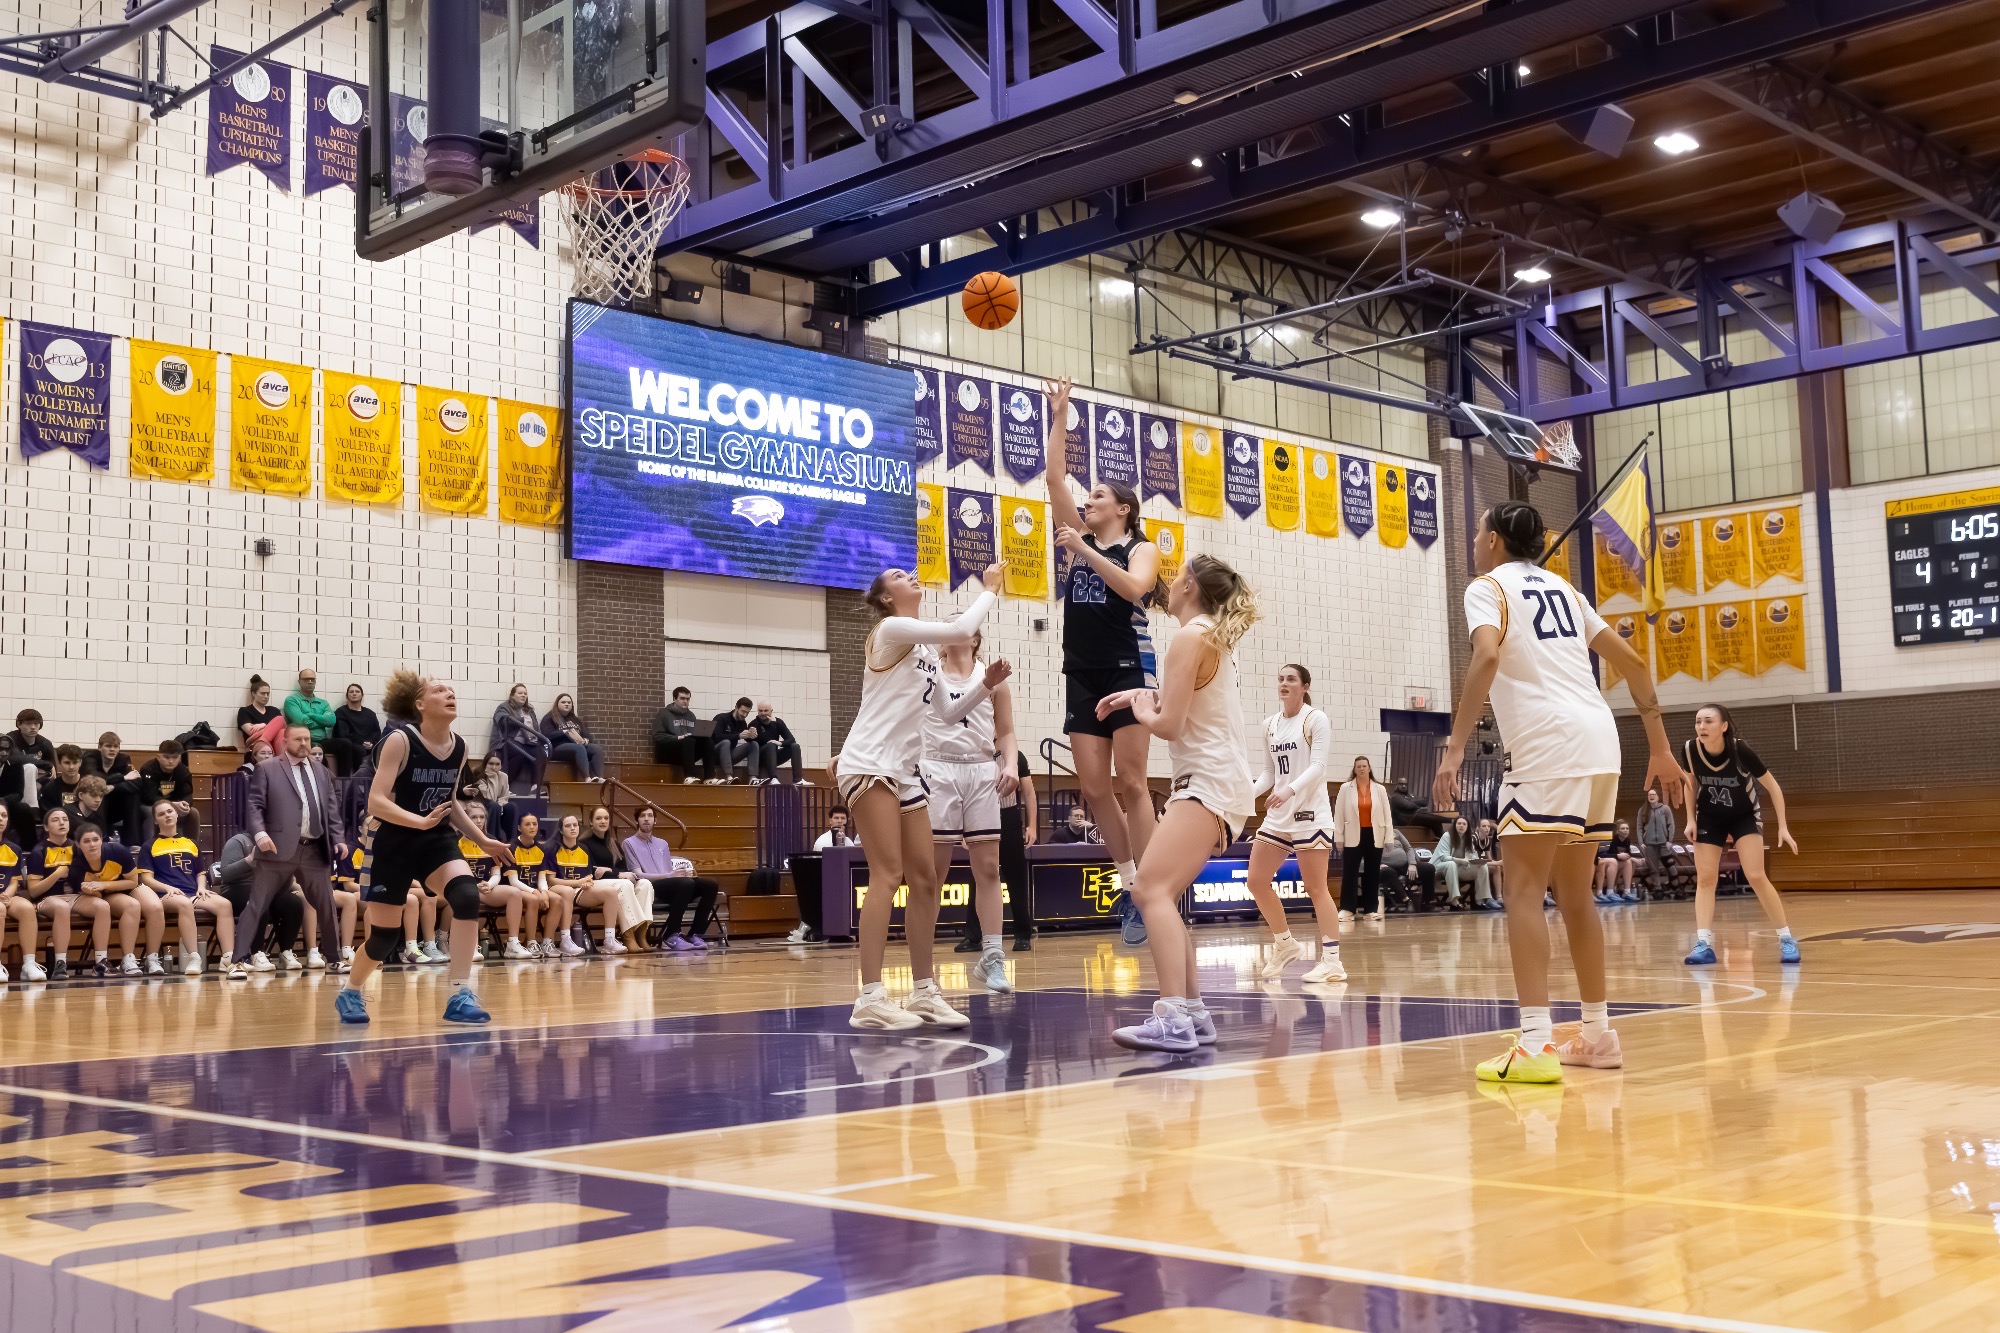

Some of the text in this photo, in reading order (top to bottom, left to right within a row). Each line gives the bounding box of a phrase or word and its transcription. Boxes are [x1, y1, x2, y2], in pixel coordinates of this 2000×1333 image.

[270, 86, 286, 102] 80
[235, 102, 267, 120] MEN'S
[313, 97, 326, 112] 19
[219, 112, 283, 138] BASKETBALL
[393, 117, 405, 132] 19
[222, 127, 279, 150] UPSTATE NY
[330, 126, 358, 142] MEN'S
[218, 140, 282, 164] CHAMPIONS
[315, 136, 357, 154] BASKETB
[318, 150, 357, 168] UPSTATE
[26, 352, 105, 379] 20 13
[36, 379, 95, 400] WOMEN'S
[138, 369, 153, 386] 20
[195, 378, 212, 396] 14
[262, 382, 288, 392] avca
[24, 392, 104, 416] VOLLEYBALL
[238, 384, 307, 413] 20 14
[330, 393, 397, 416] 20 15
[353, 396, 378, 406] avca
[444, 408, 468, 419] avca
[628, 366, 874, 449] WELCOME TO
[1002, 402, 1011, 414] 19
[23, 408, 106, 431] TOURNAMENT
[156, 412, 191, 427] MEN'S
[256, 413, 288, 428] MEN'S
[424, 407, 484, 429] 20 15
[956, 412, 984, 425] WOMEN'S
[38, 427, 92, 446] FINALIST
[136, 424, 210, 444] VOLLEYBALL
[241, 425, 302, 444] VOLLEYBALL
[349, 426, 380, 440] MEN'S
[952, 422, 988, 436] BASKETBALL
[1008, 422, 1034, 435] WOMEN'S
[440, 438, 470, 452] MEN'S
[504, 428, 562, 448] 20 15
[1004, 432, 1038, 447] BASKETBALL
[1102, 439, 1128, 452] WOMEN'S
[138, 438, 210, 459] TOURNAMENT
[244, 440, 289, 456] DIVISION
[336, 438, 392, 455] VOLLEYBALL
[580, 407, 913, 496] SPEIDEL GYMNASIUM
[953, 444, 990, 458] CHAMPIONS
[134, 452, 210, 474] SEMI-FINALIST
[236, 452, 306, 470] ALL-AMERICAN
[337, 451, 380, 466] DIVISION
[428, 450, 479, 467] VOLLEYBALL
[1010, 455, 1036, 466] FINALIST
[1099, 449, 1134, 462] BASKETBALL
[1274, 454, 1288, 464] NCAA
[331, 464, 398, 481] ALL-AMERICAN
[429, 464, 470, 478] DIVISION
[512, 460, 555, 476] WOMEN'S
[1231, 465, 1255, 476] WOMEN'S
[424, 476, 485, 492] ALL-AMERICAN
[506, 472, 561, 491] VOLLEYBALL
[638, 460, 672, 476] HOME
[672, 464, 687, 478] OF
[687, 466, 706, 482] THE
[744, 476, 789, 494] COLLEGE
[832, 488, 867, 506] EAGLES
[1228, 474, 1258, 486] BASKETBALL
[1228, 484, 1259, 496] TOURNAMENT
[1345, 488, 1368, 498] WOMEN'S
[515, 500, 552, 515] FINALIST
[1905, 490, 2000, 513] Home of the Soarin
[958, 529, 988, 541] WOMEN'S
[1951, 512, 1998, 542] 6:05
[953, 539, 992, 552] BASKETBALL
[1010, 537, 1039, 548] WOMEN'S
[953, 548, 992, 562] TOURNAMENT
[1004, 546, 1044, 558] BASKETBALL
[1895, 547, 1930, 562] EAGLES
[1012, 568, 1039, 578] FINALIST
[1916, 562, 1930, 584] 4
[1072, 570, 1107, 603] 22
[1905, 603, 1925, 612] FOULS
[1949, 595, 1999, 608] PLAYER FOULS
[1522, 590, 1578, 640] 20
[1932, 613, 1941, 628] 5
[922, 678, 936, 705] 2
[1278, 755, 1290, 775] 10
[412, 768, 458, 784] HARTWIC
[419, 787, 452, 812] 15
[170, 852, 192, 874] EC
[1193, 880, 1311, 902] SOARIN AGLE
